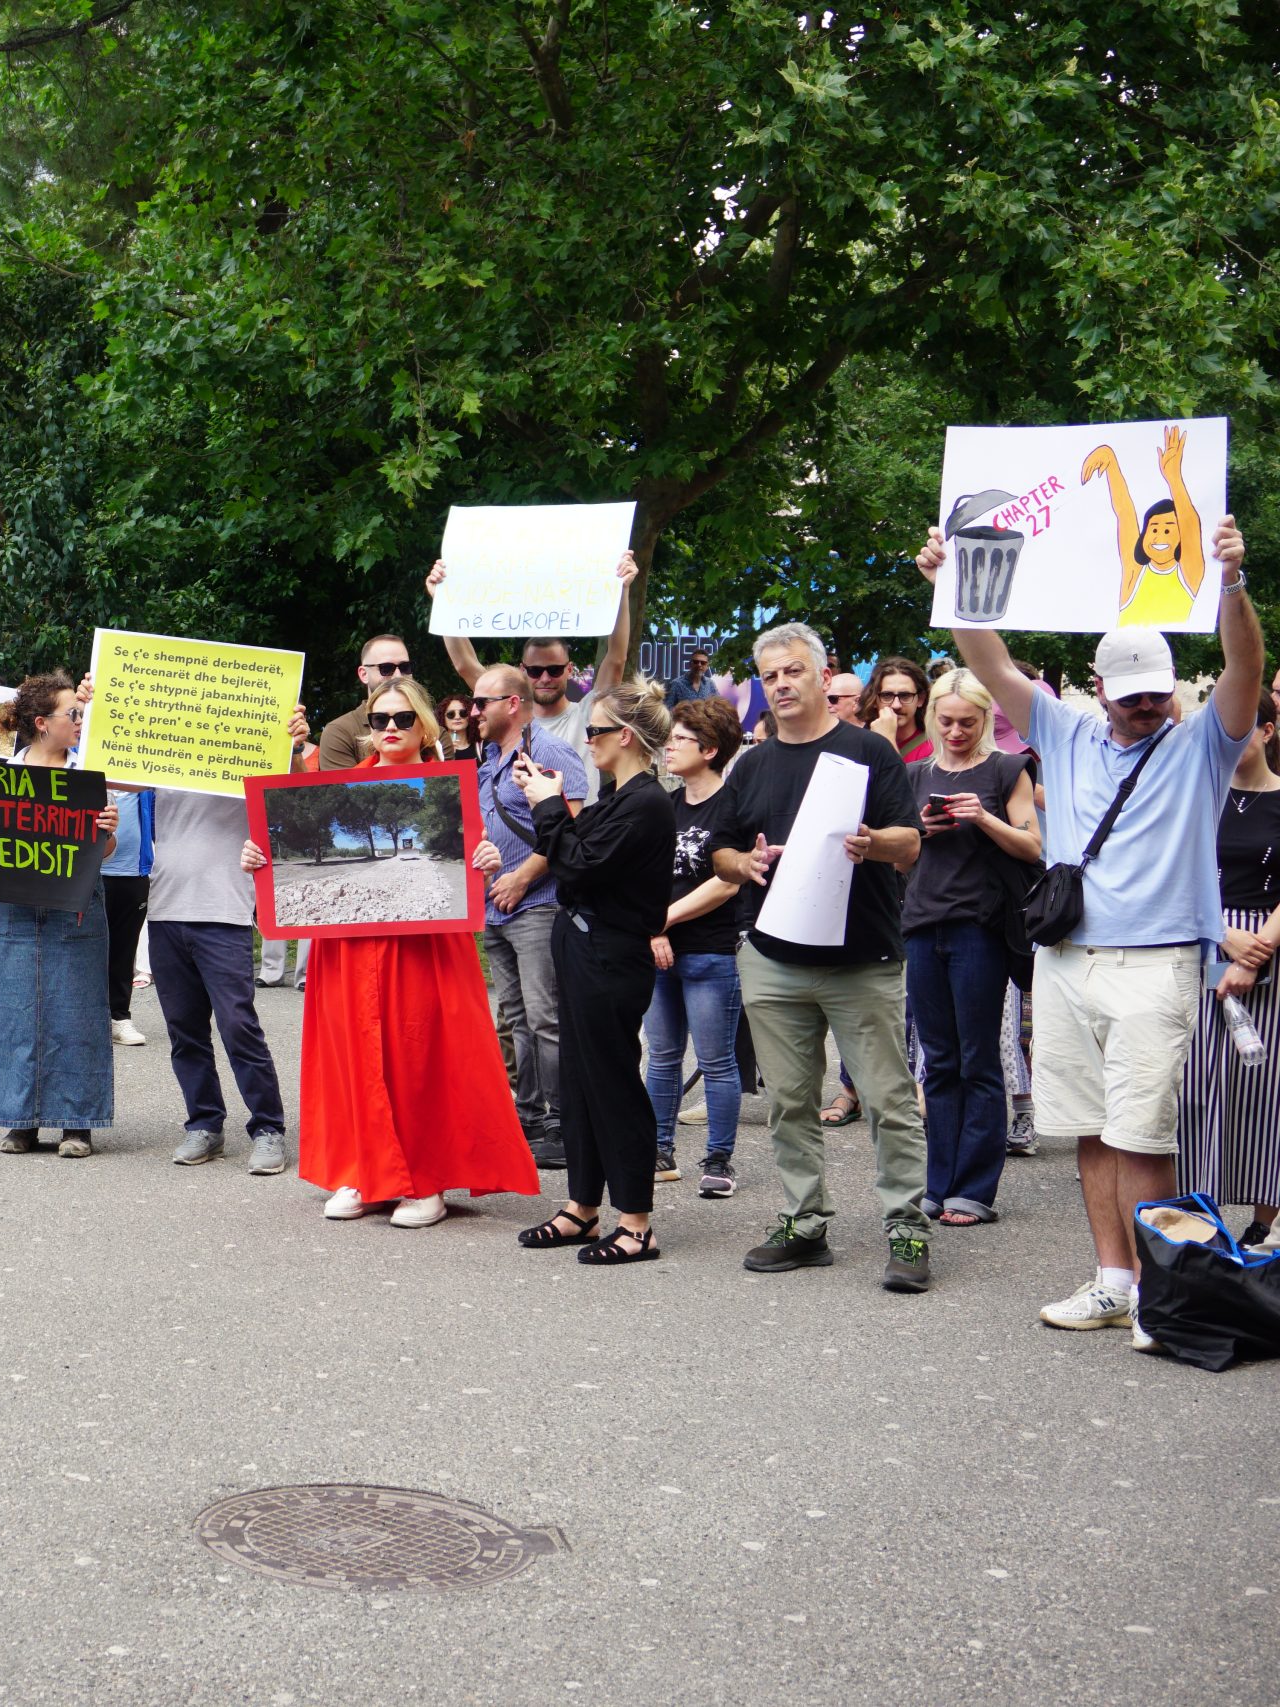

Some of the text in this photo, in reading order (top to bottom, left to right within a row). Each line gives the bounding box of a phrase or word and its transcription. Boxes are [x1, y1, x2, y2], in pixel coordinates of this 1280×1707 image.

[993, 476, 1065, 532] CHAPTER
[1026, 505, 1050, 536] 27
[458, 613, 483, 630] në
[114, 646, 284, 677] Se ç'e shempnë derbederët,
[122, 663, 272, 691] Mercenarët dhe bejlerët,
[110, 677, 280, 709] Se ç'e shtypnë jabanxhinjtë,
[104, 693, 281, 725] Se ç'e shtrythnë fajdexhinjtë,
[109, 709, 272, 740] Se ç'e pren' e se ç'e vranë,
[101, 740, 133, 753] Nënë
[136, 744, 192, 760] thundrën
[208, 753, 273, 770] përdhunës
[112, 725, 266, 755] Ç'e shkretuan anembanë,
[107, 757, 137, 769] Anës
[142, 760, 185, 777] Vjosës,
[189, 767, 217, 779] anës
[50, 769, 68, 801] E
